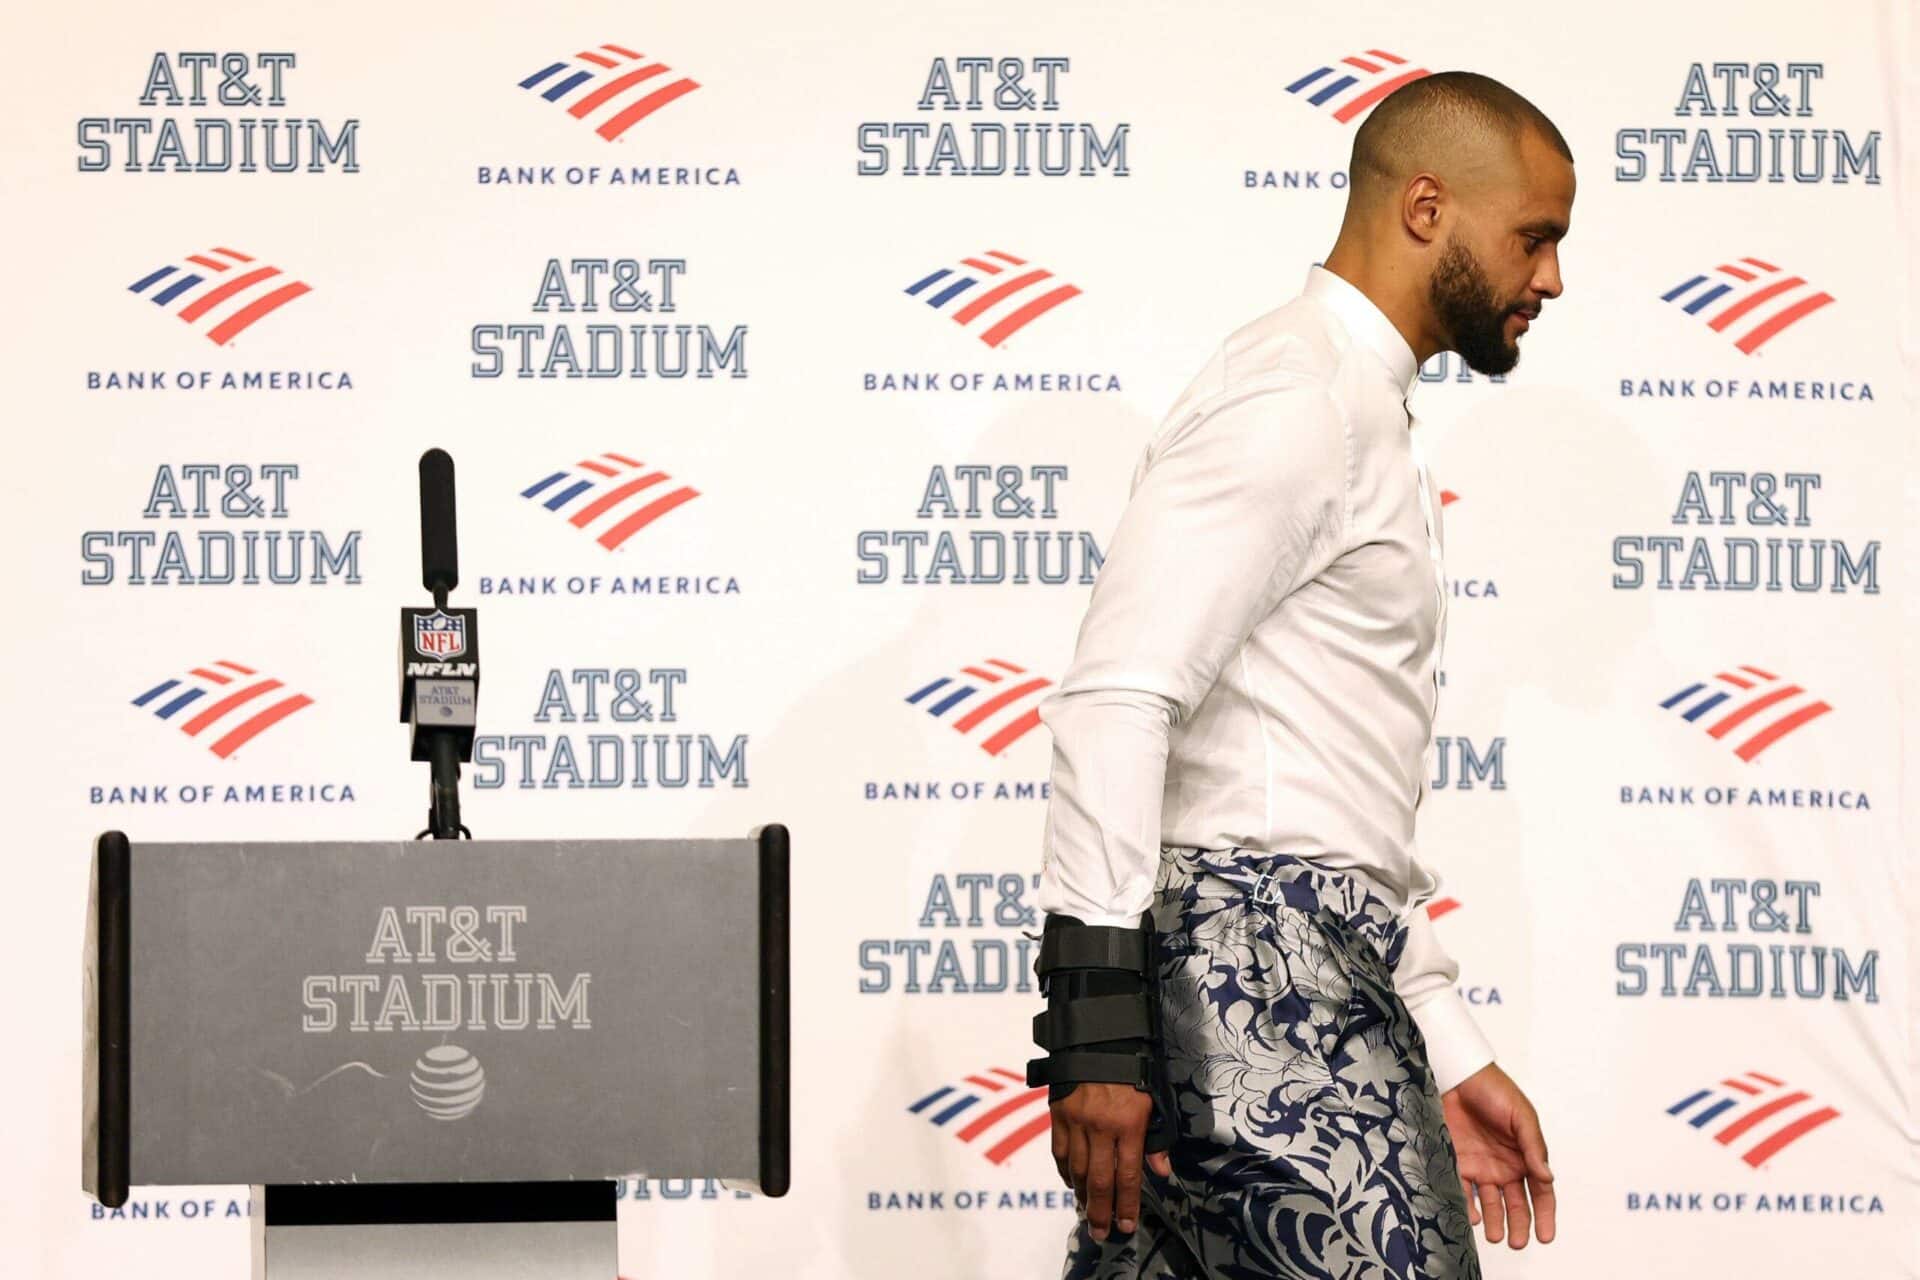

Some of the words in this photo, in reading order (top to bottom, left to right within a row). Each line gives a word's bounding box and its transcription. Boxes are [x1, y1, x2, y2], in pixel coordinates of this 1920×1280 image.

[138, 51, 297, 108] AT&T
[916, 56, 1070, 112] AT&T
[1674, 61, 1825, 118] AT&T
[76, 117, 361, 174] STADIUM
[856, 121, 1131, 178] STADIUM
[1615, 127, 1882, 186] STADIUM
[477, 166, 555, 185] BANK
[565, 166, 601, 185] OF
[609, 167, 741, 186] AMERICA
[1244, 170, 1320, 189] BANK
[1329, 171, 1348, 190] O
[531, 258, 687, 313] AT&T
[471, 323, 749, 379] STADIUM
[87, 371, 166, 390] BANK
[175, 371, 212, 390] OF
[220, 371, 353, 390] AMERICA
[863, 373, 939, 391] BANK
[949, 373, 984, 392] OF
[992, 373, 1121, 392] AMERICA
[1620, 379, 1695, 398] BANK
[1705, 379, 1739, 398] OF
[1748, 381, 1874, 401] AMERICA
[142, 463, 300, 519] AT&T
[916, 464, 1069, 520] AT&T
[1671, 470, 1822, 528] AT&T
[80, 530, 362, 586] STADIUM
[479, 577, 556, 595] BANK
[567, 576, 601, 595] OF
[610, 576, 740, 595] AMERICA
[1612, 535, 1881, 595] STADIUM
[406, 662, 476, 676] NFLN
[422, 632, 460, 652] NFL
[533, 668, 687, 723] AT&T
[473, 734, 749, 788] STADIUM
[90, 785, 168, 805] BANK
[178, 785, 214, 804] OF
[223, 784, 355, 803] AMERICA
[864, 782, 940, 800] BANK
[950, 782, 985, 800] OF
[1620, 786, 1694, 804] BANK
[1704, 787, 1737, 805] OF
[1747, 788, 1871, 810] AMERICA
[365, 905, 528, 963] AT&T
[1673, 878, 1821, 936] AT&T
[858, 938, 1042, 993] STADI
[1615, 943, 1880, 1005] STADIUM
[302, 972, 593, 1033] STADIUM
[91, 1201, 171, 1221] BANK
[180, 1200, 217, 1219] OF
[867, 1191, 945, 1211] BANK
[953, 1191, 988, 1210] OF
[997, 1190, 1075, 1209] AMER
[1627, 1192, 1702, 1211] BANK
[1712, 1193, 1746, 1212] OF
[1755, 1194, 1884, 1213] AMERICA
